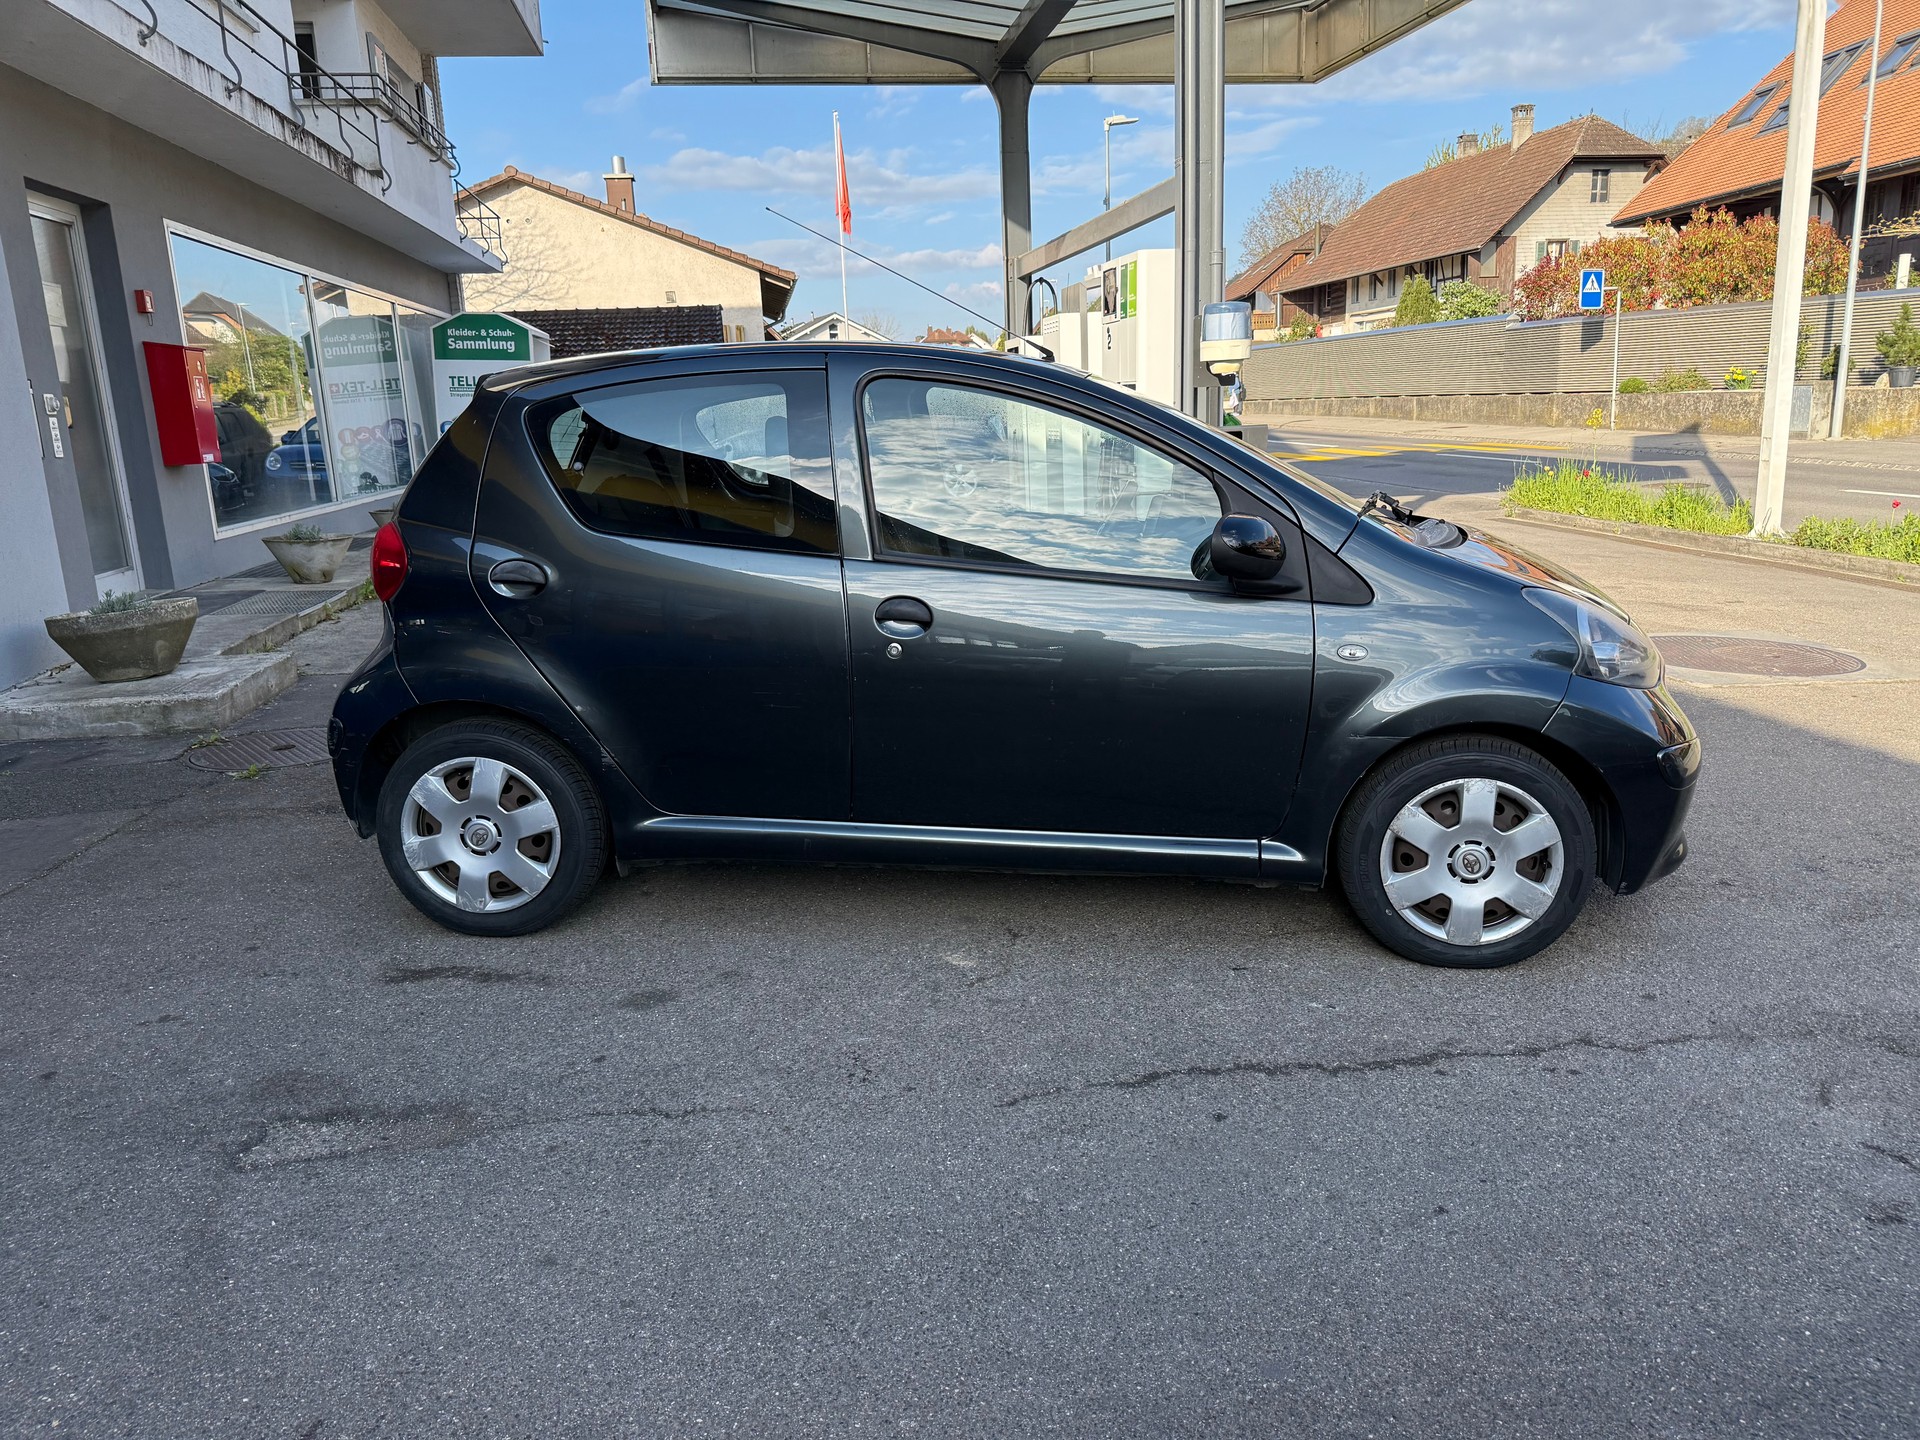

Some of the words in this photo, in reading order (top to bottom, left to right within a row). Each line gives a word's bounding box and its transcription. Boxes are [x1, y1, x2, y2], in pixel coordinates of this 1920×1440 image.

[447, 328, 479, 337] Kleider-
[480, 328, 487, 337] &
[488, 328, 515, 337] Schuh-
[447, 337, 516, 353] Sammlung
[1107, 333, 1112, 350] 2
